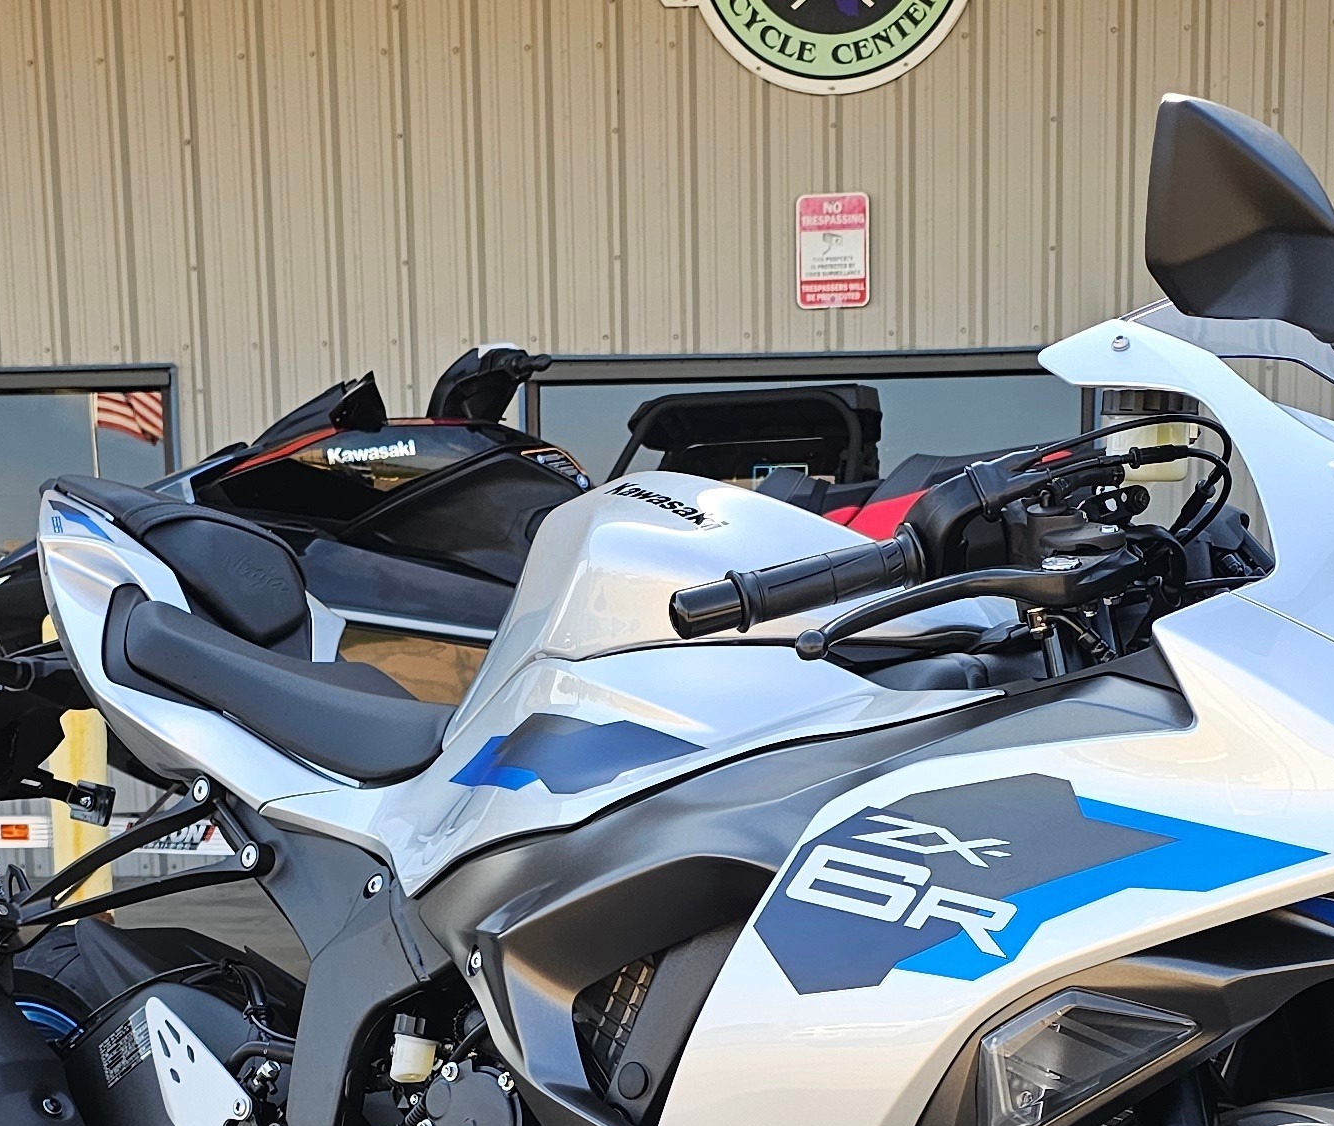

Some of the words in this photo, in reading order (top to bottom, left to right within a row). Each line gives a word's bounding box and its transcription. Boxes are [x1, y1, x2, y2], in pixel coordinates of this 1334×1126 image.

[729, 0, 817, 64] CYCLE
[801, 213, 865, 226] TRESPASSING
[822, 201, 842, 214] NO
[327, 439, 416, 466] Kawasaki
[604, 482, 730, 532] Kawasaki
[785, 844, 1018, 960] 6R
